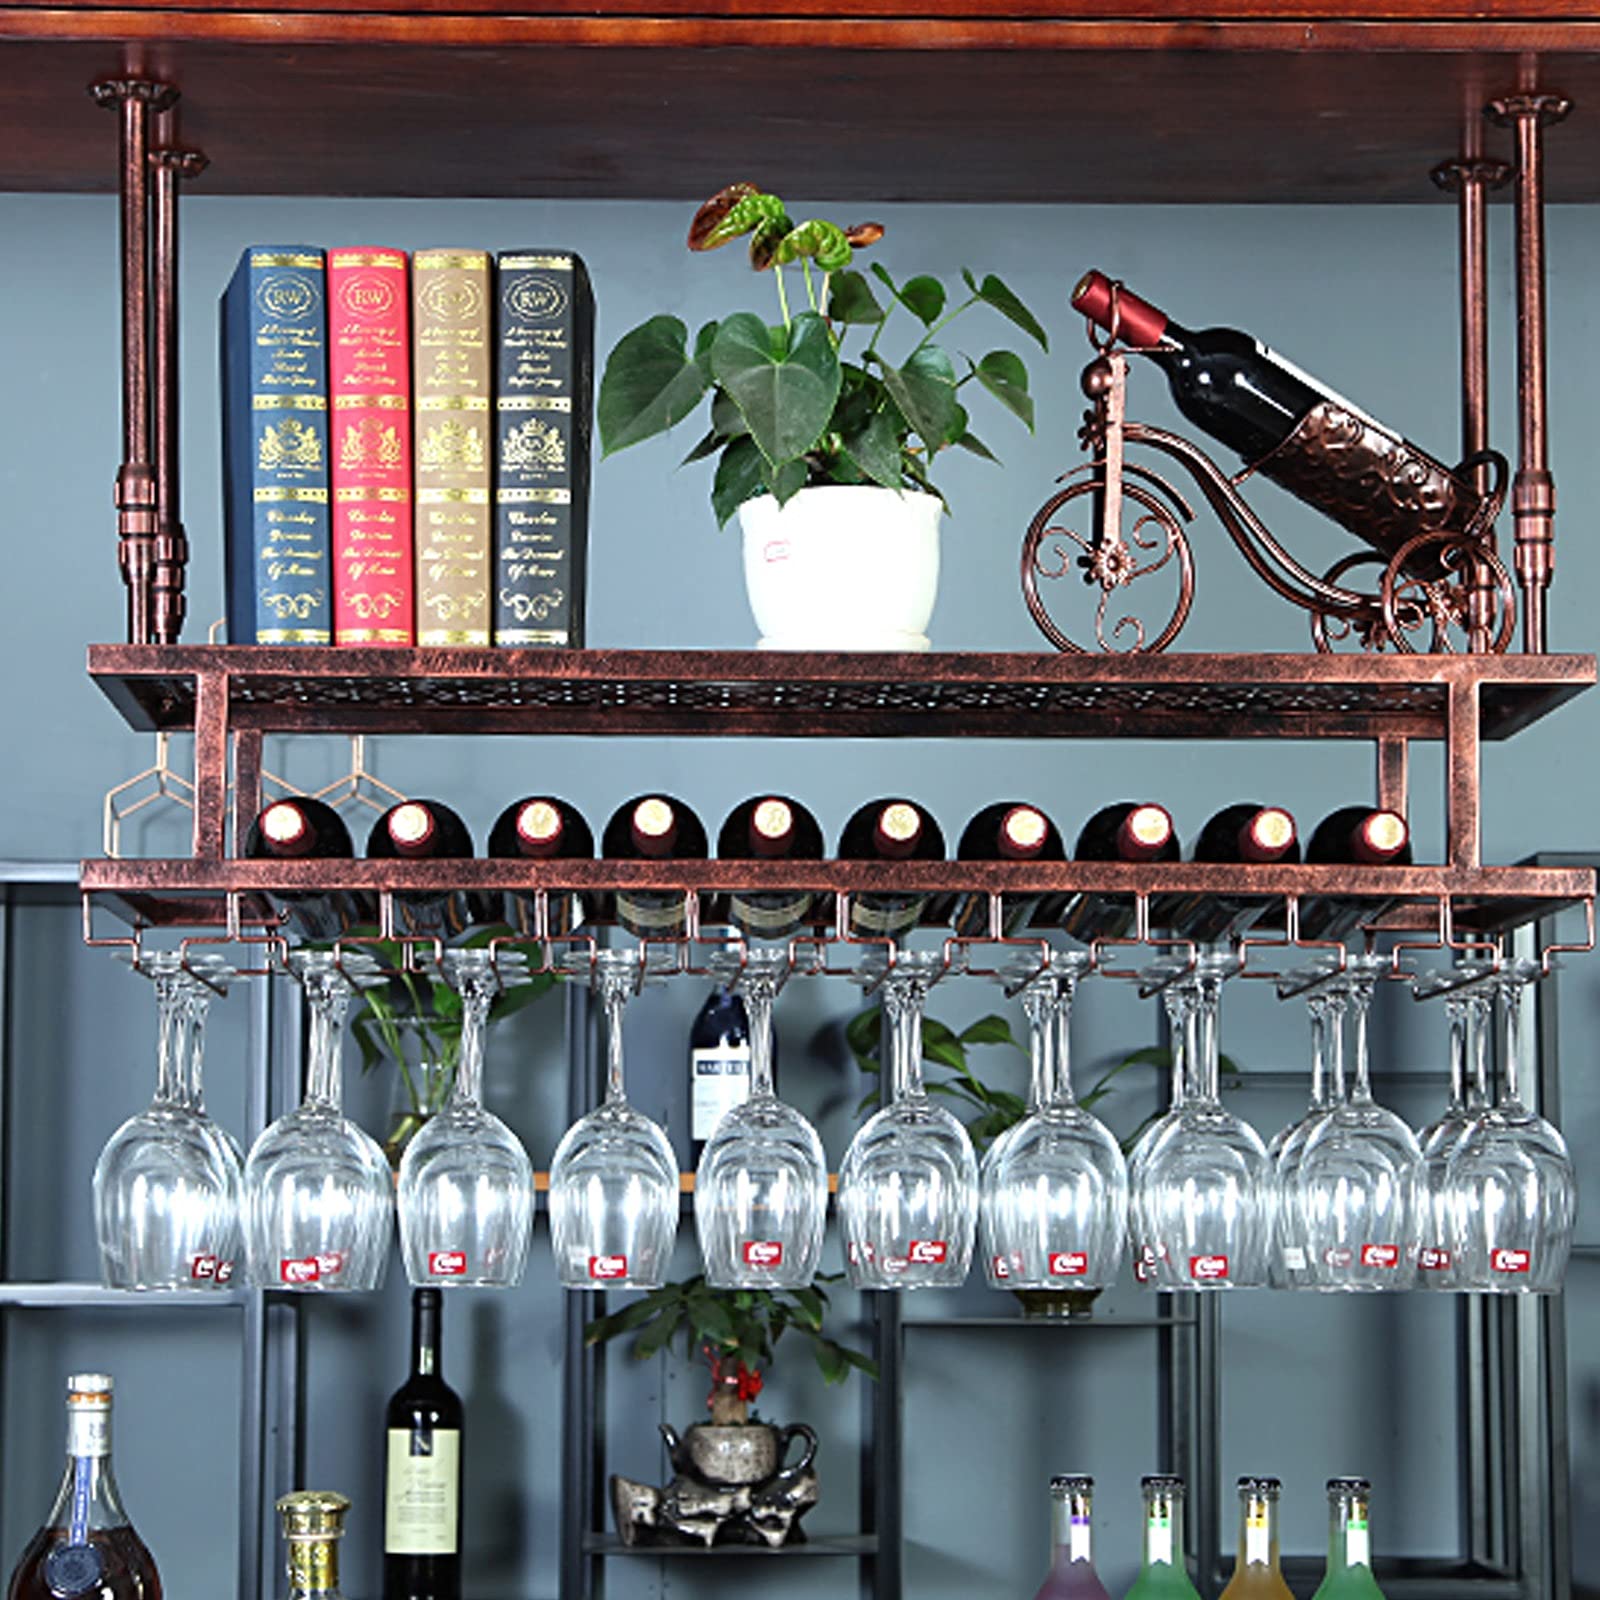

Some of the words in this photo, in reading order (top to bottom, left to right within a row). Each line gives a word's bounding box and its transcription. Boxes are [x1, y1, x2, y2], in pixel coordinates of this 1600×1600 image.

[273, 289, 305, 305] RW
[355, 289, 385, 305] RW
[520, 291, 551, 308] RW
